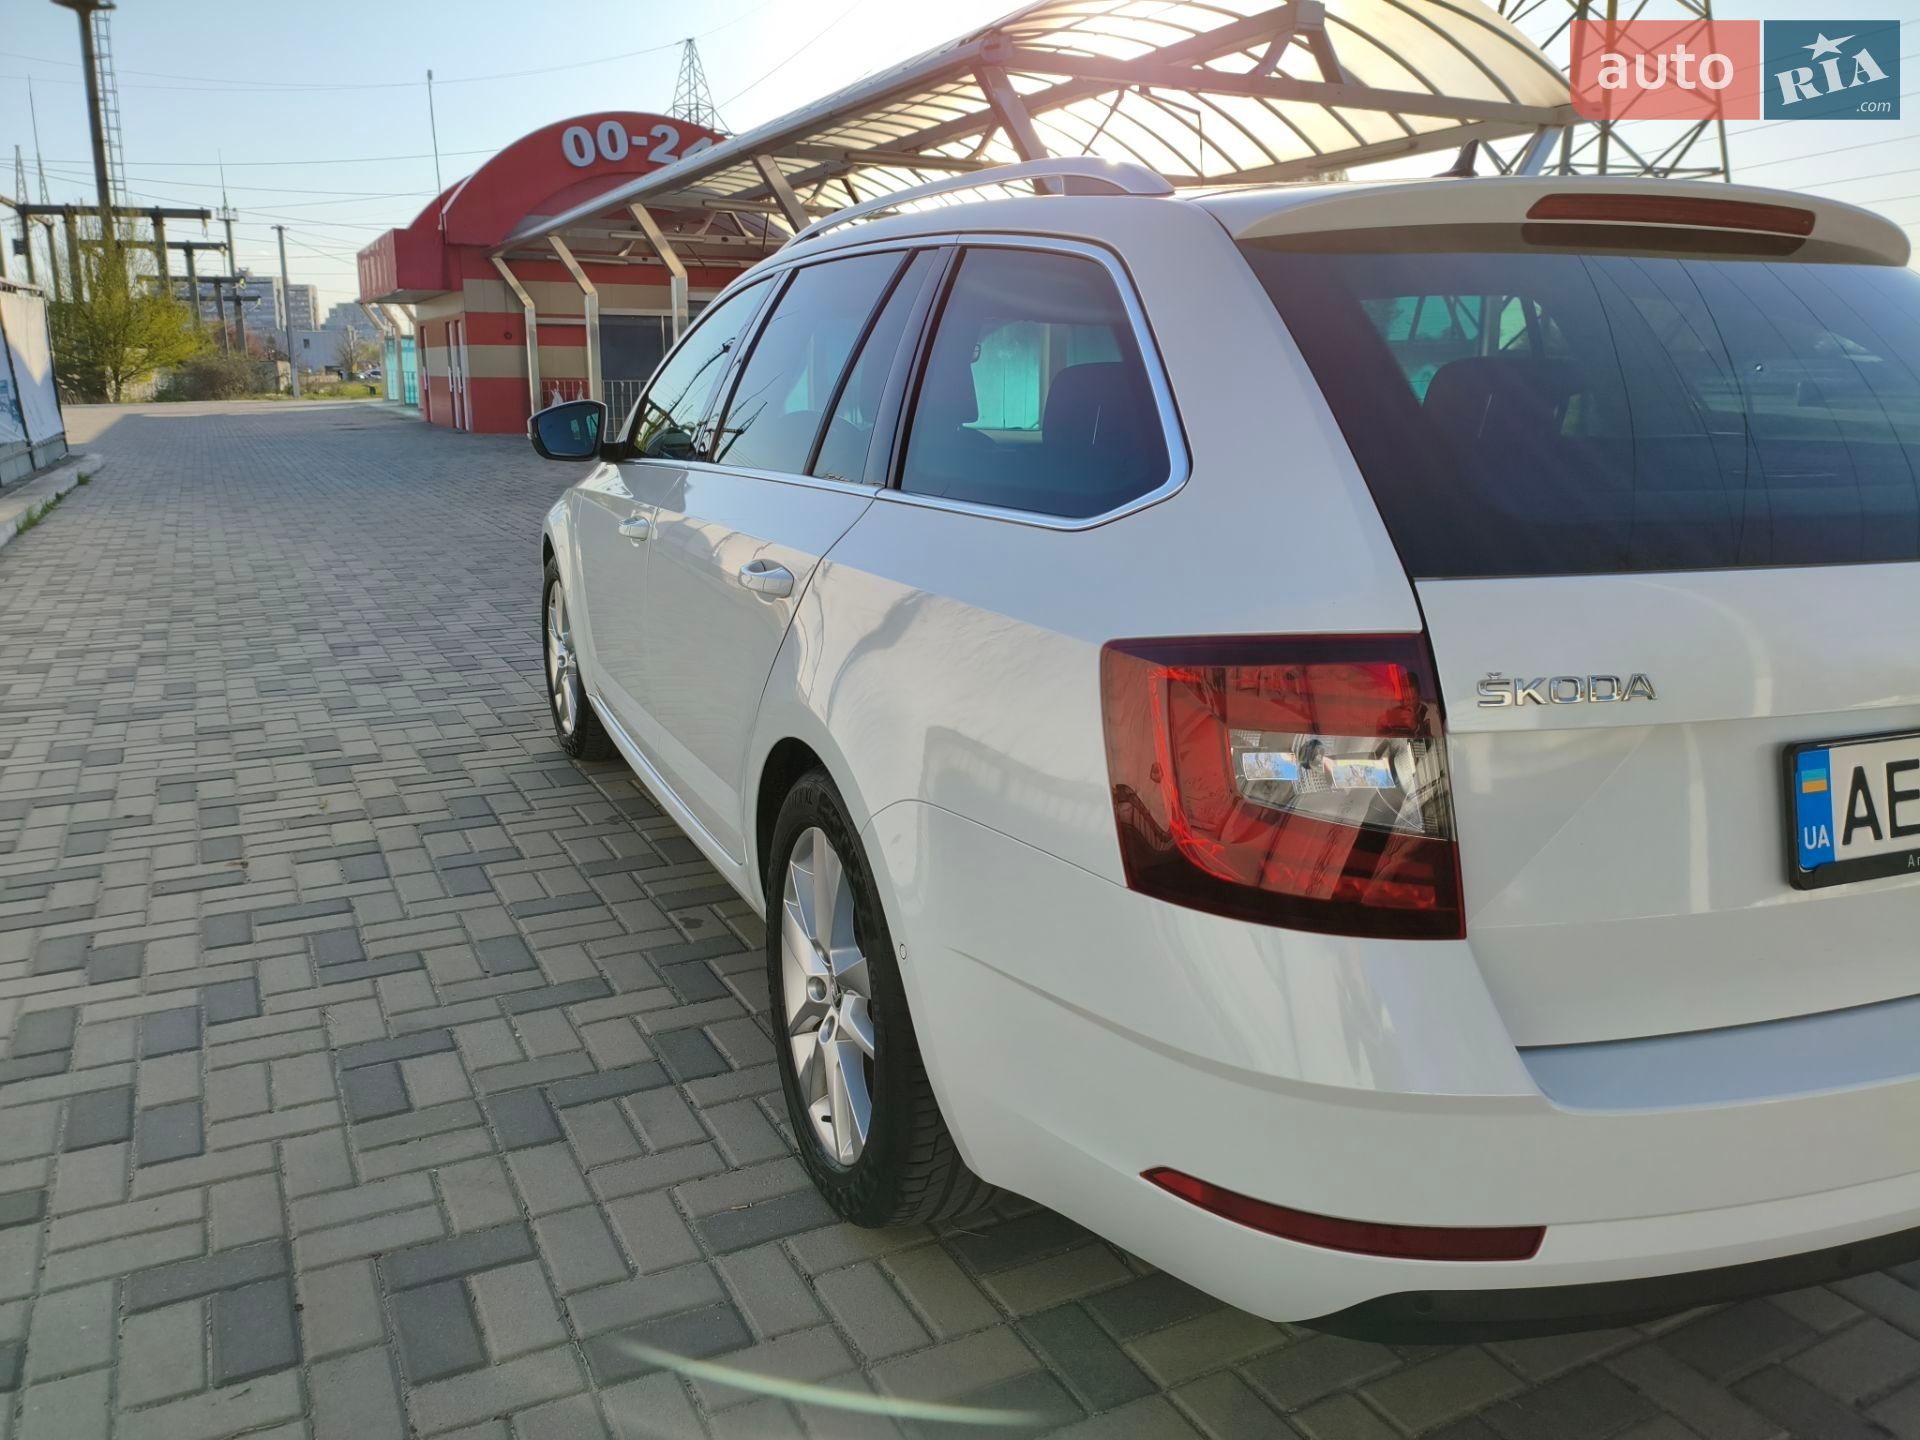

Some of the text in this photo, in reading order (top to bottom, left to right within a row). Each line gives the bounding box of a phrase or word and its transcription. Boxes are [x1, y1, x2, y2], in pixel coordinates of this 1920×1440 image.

[1476, 672, 1659, 708] ŠKODA
[1841, 758, 1920, 846] AE
[1803, 824, 1831, 850] UA
